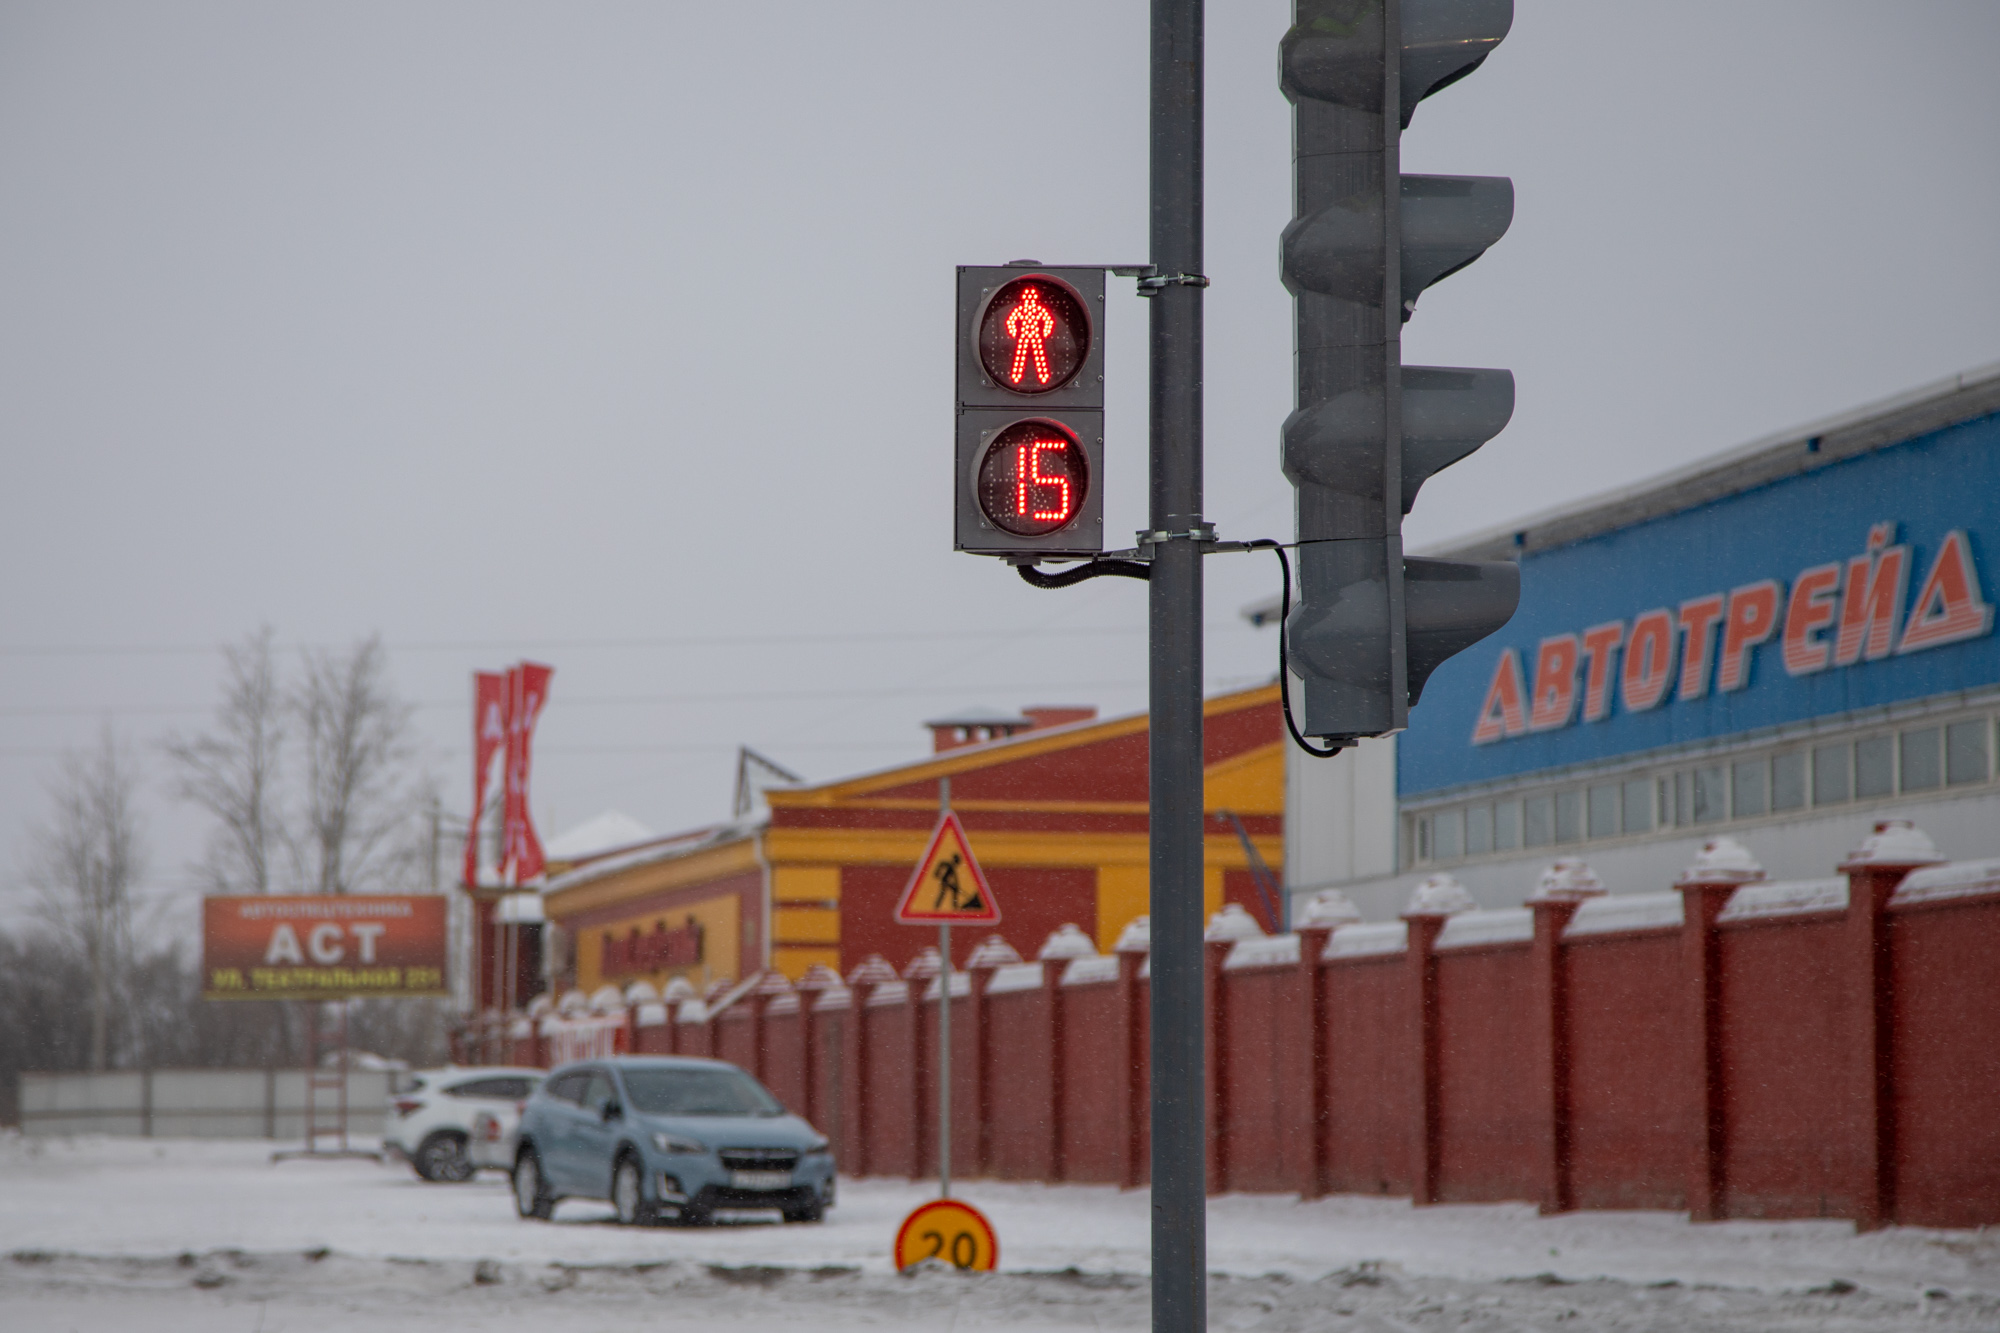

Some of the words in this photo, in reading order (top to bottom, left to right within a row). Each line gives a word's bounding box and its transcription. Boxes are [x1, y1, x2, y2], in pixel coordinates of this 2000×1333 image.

[1017, 441, 1068, 519] 15
[1472, 520, 1993, 746] АВТОТРЕЙД
[264, 923, 385, 964] АСТ
[921, 1230, 977, 1269] 20
